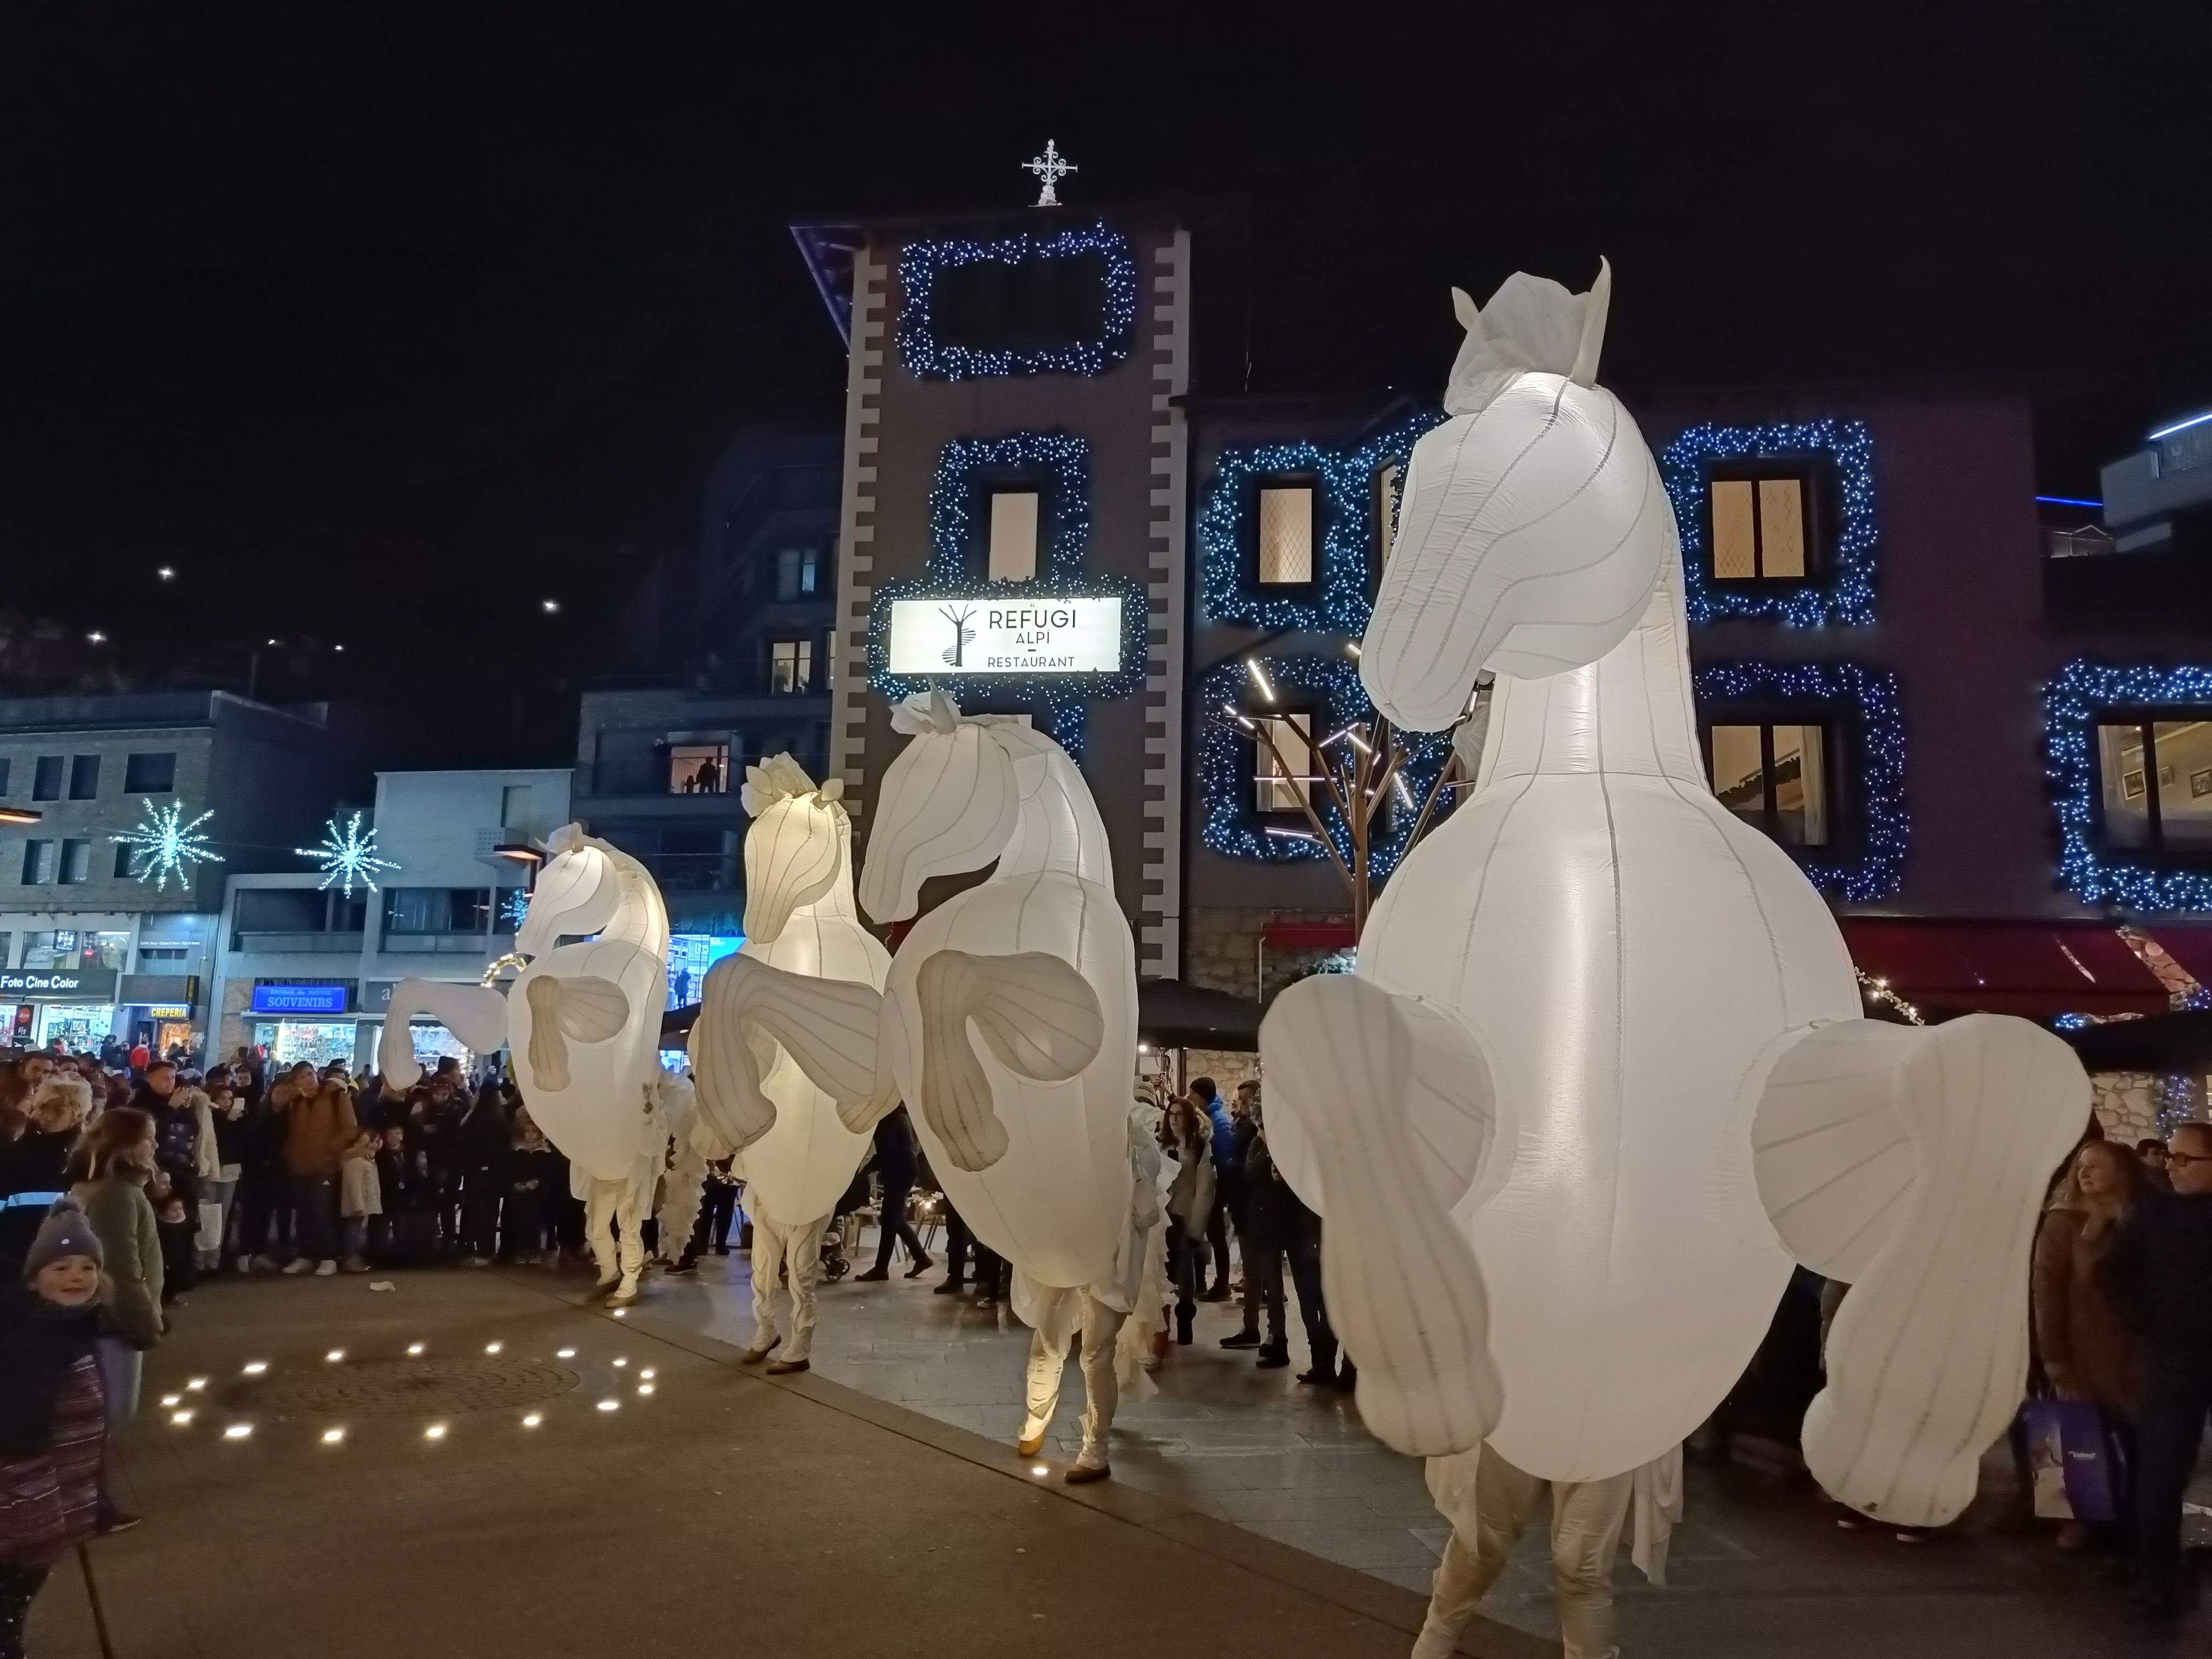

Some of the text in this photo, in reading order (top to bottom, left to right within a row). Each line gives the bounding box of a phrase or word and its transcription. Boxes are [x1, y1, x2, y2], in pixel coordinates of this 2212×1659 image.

[989, 610, 1076, 629] REFUGI
[988, 657, 1075, 667] RESTAURANT
[1, 975, 78, 988] Foto Cine Color
[267, 996, 333, 1008] SOUVENIRS
[152, 1007, 186, 1017] CREPERIA
